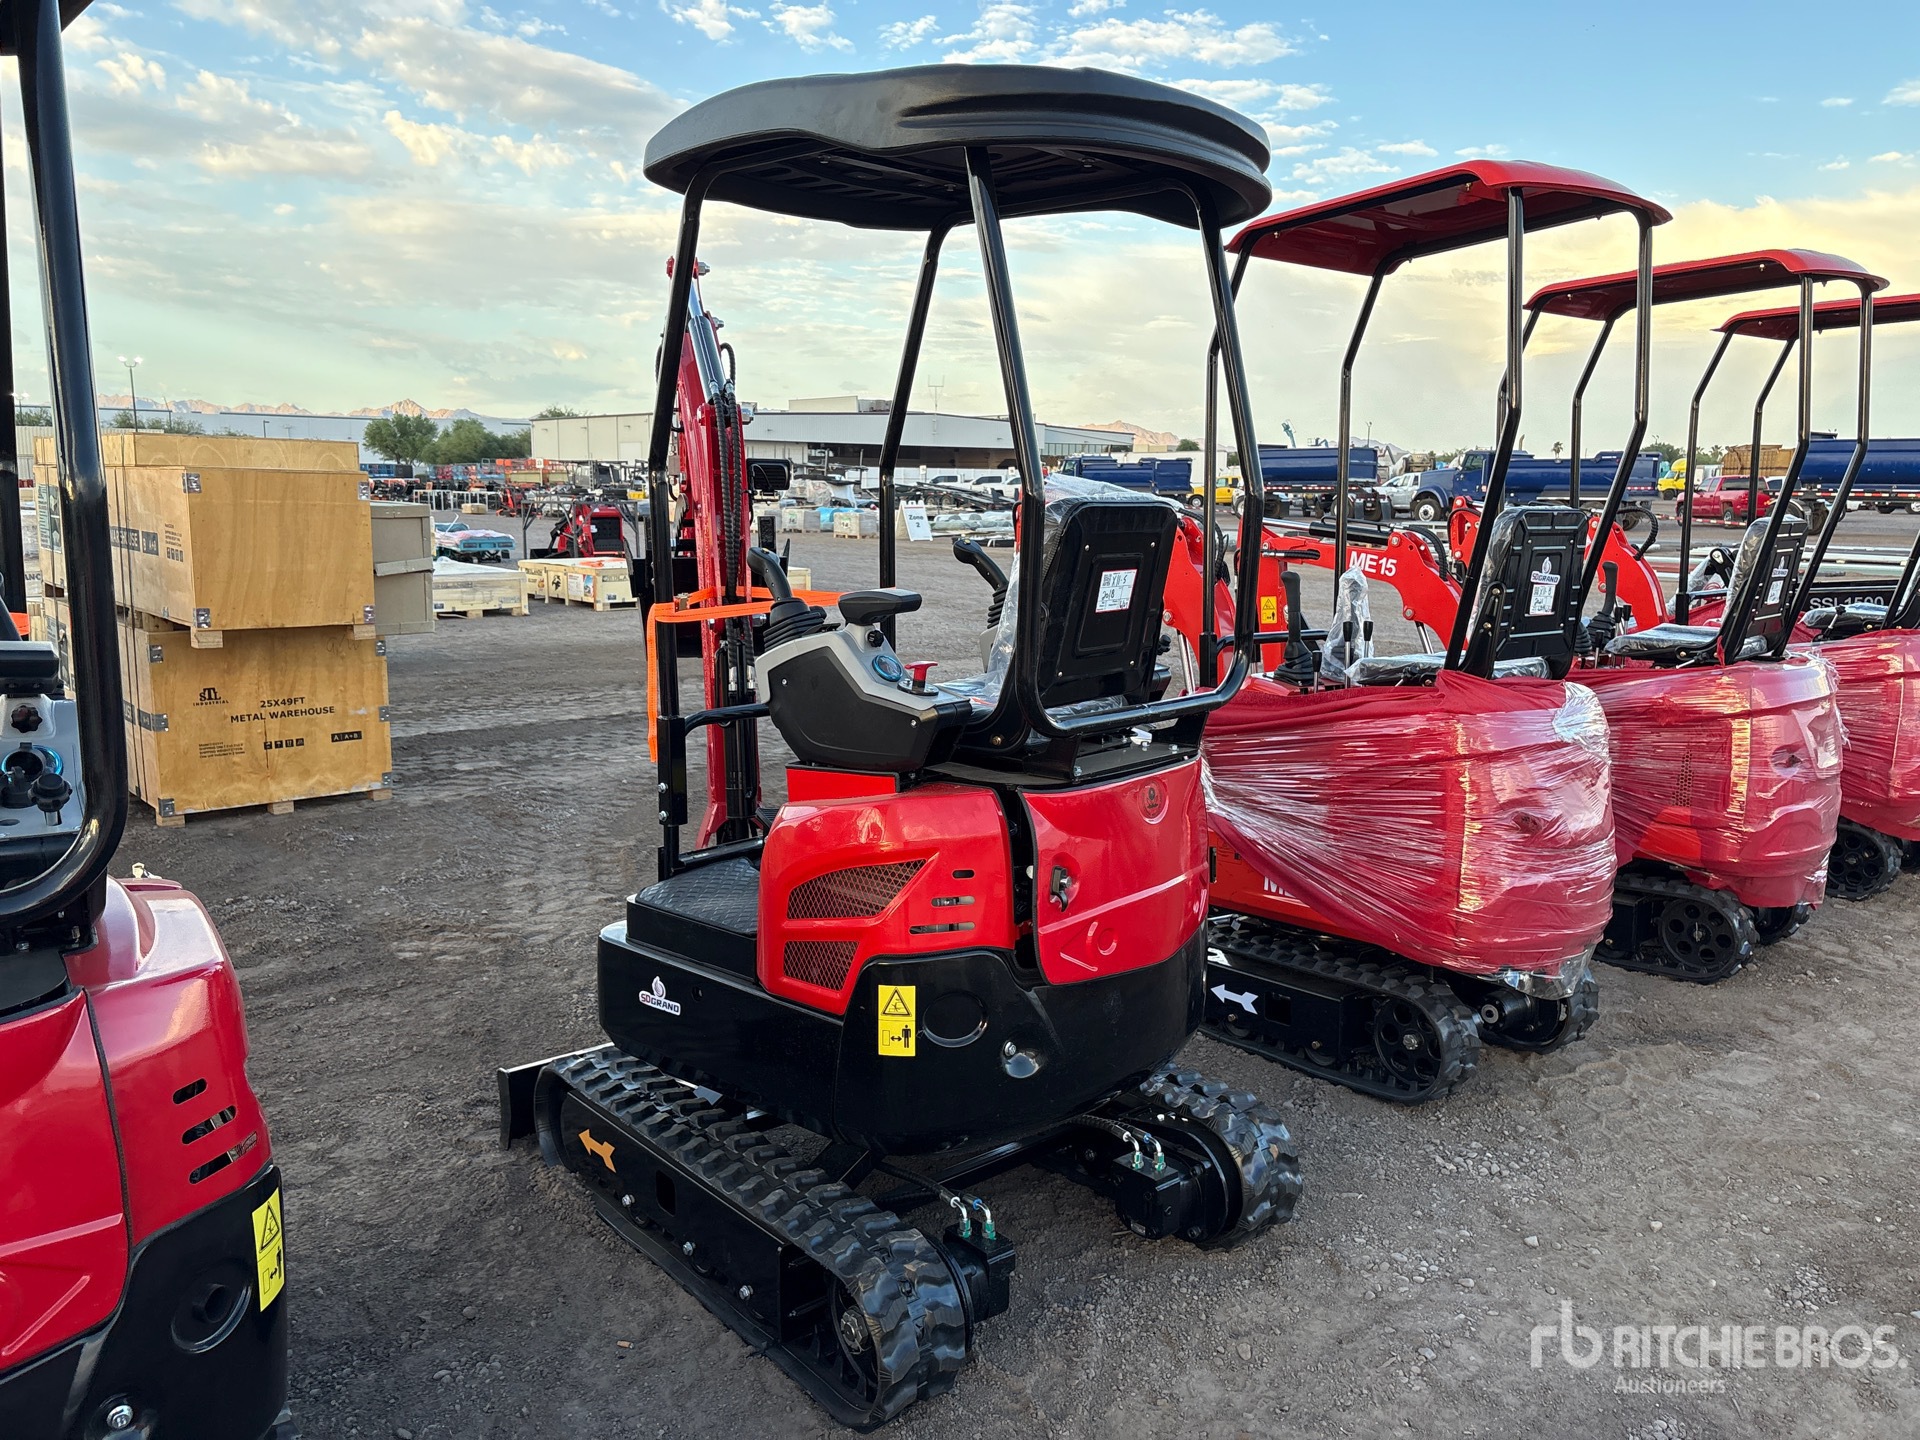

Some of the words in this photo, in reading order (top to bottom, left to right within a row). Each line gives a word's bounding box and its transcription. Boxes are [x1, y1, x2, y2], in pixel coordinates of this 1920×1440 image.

[1349, 550, 1398, 577] ME15
[1532, 573, 1559, 583] SDGRAND
[260, 697, 305, 708] 25X49FT
[230, 712, 266, 723] METAL
[269, 706, 335, 720] WAREHOUSE
[641, 993, 680, 1013] SDGRAND
